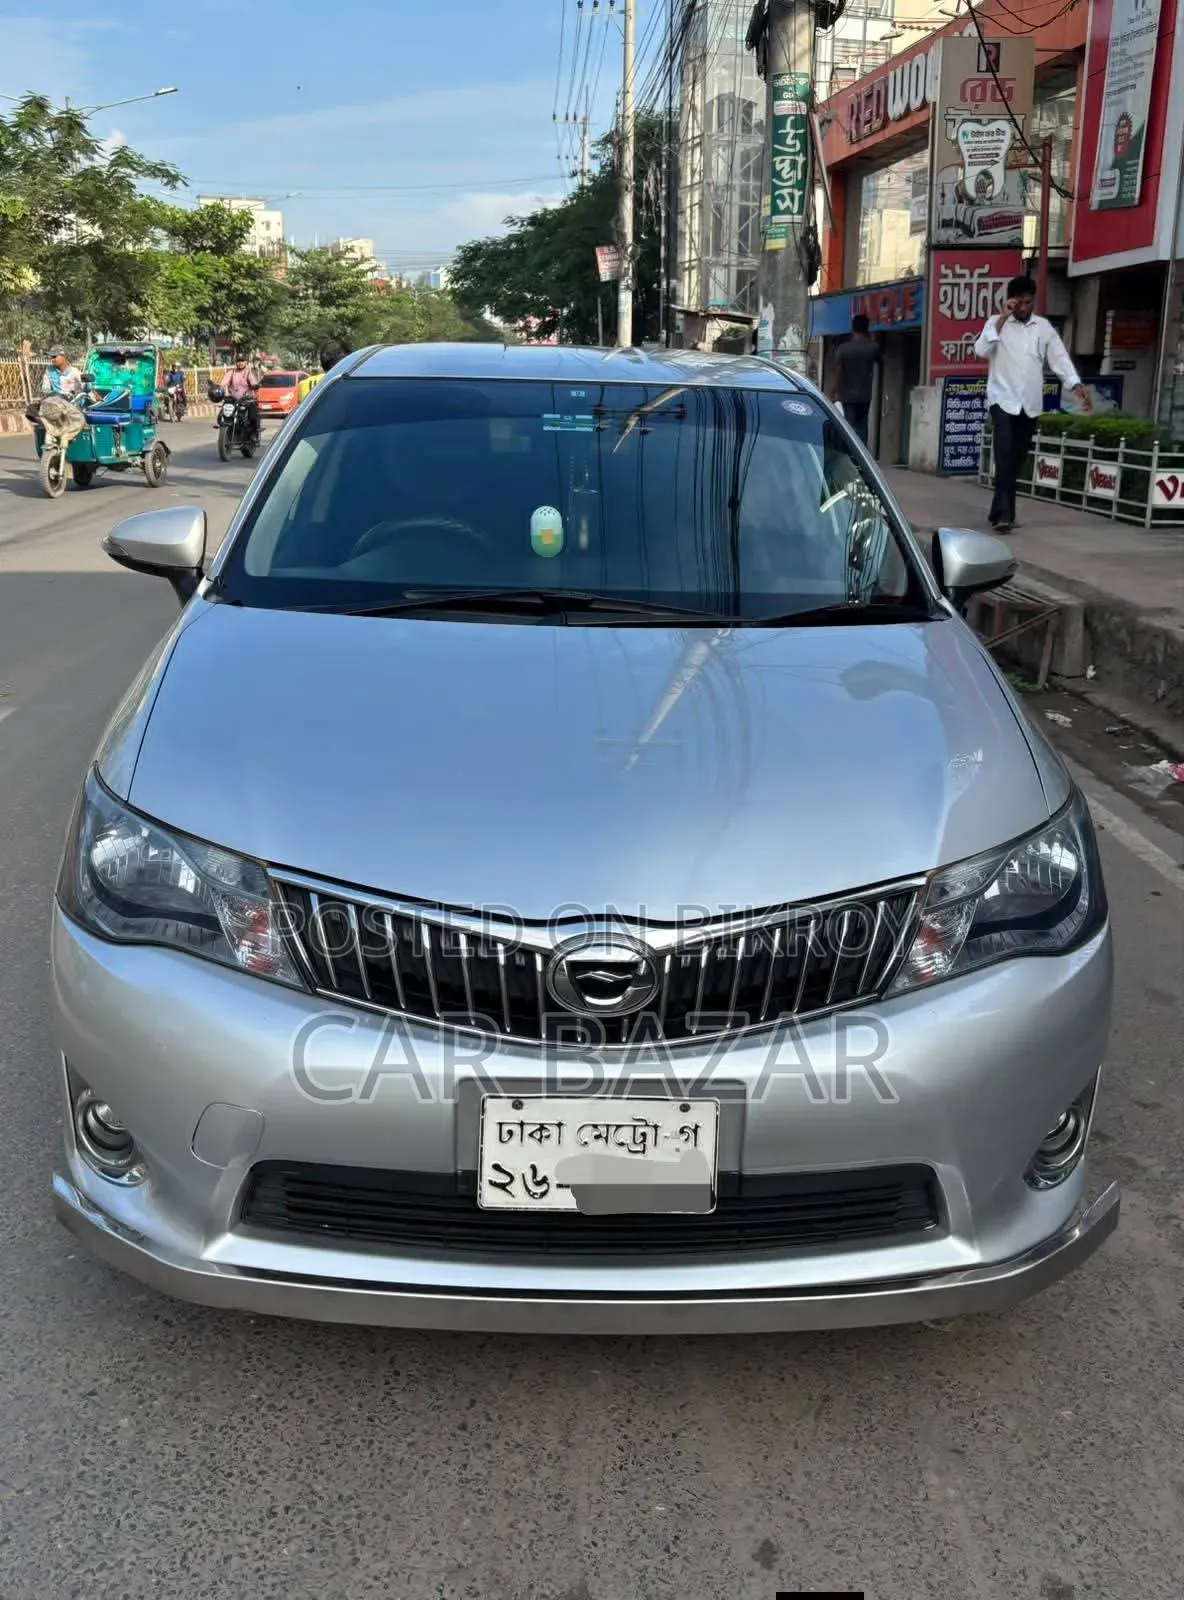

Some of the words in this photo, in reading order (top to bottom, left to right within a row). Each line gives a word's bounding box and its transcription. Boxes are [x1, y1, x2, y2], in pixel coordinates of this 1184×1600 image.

[847, 76, 887, 142] RED
[1156, 475, 1184, 502] V
[496, 1120, 564, 1146] ঢাকা
[488, 1163, 571, 1200] ২৬-
